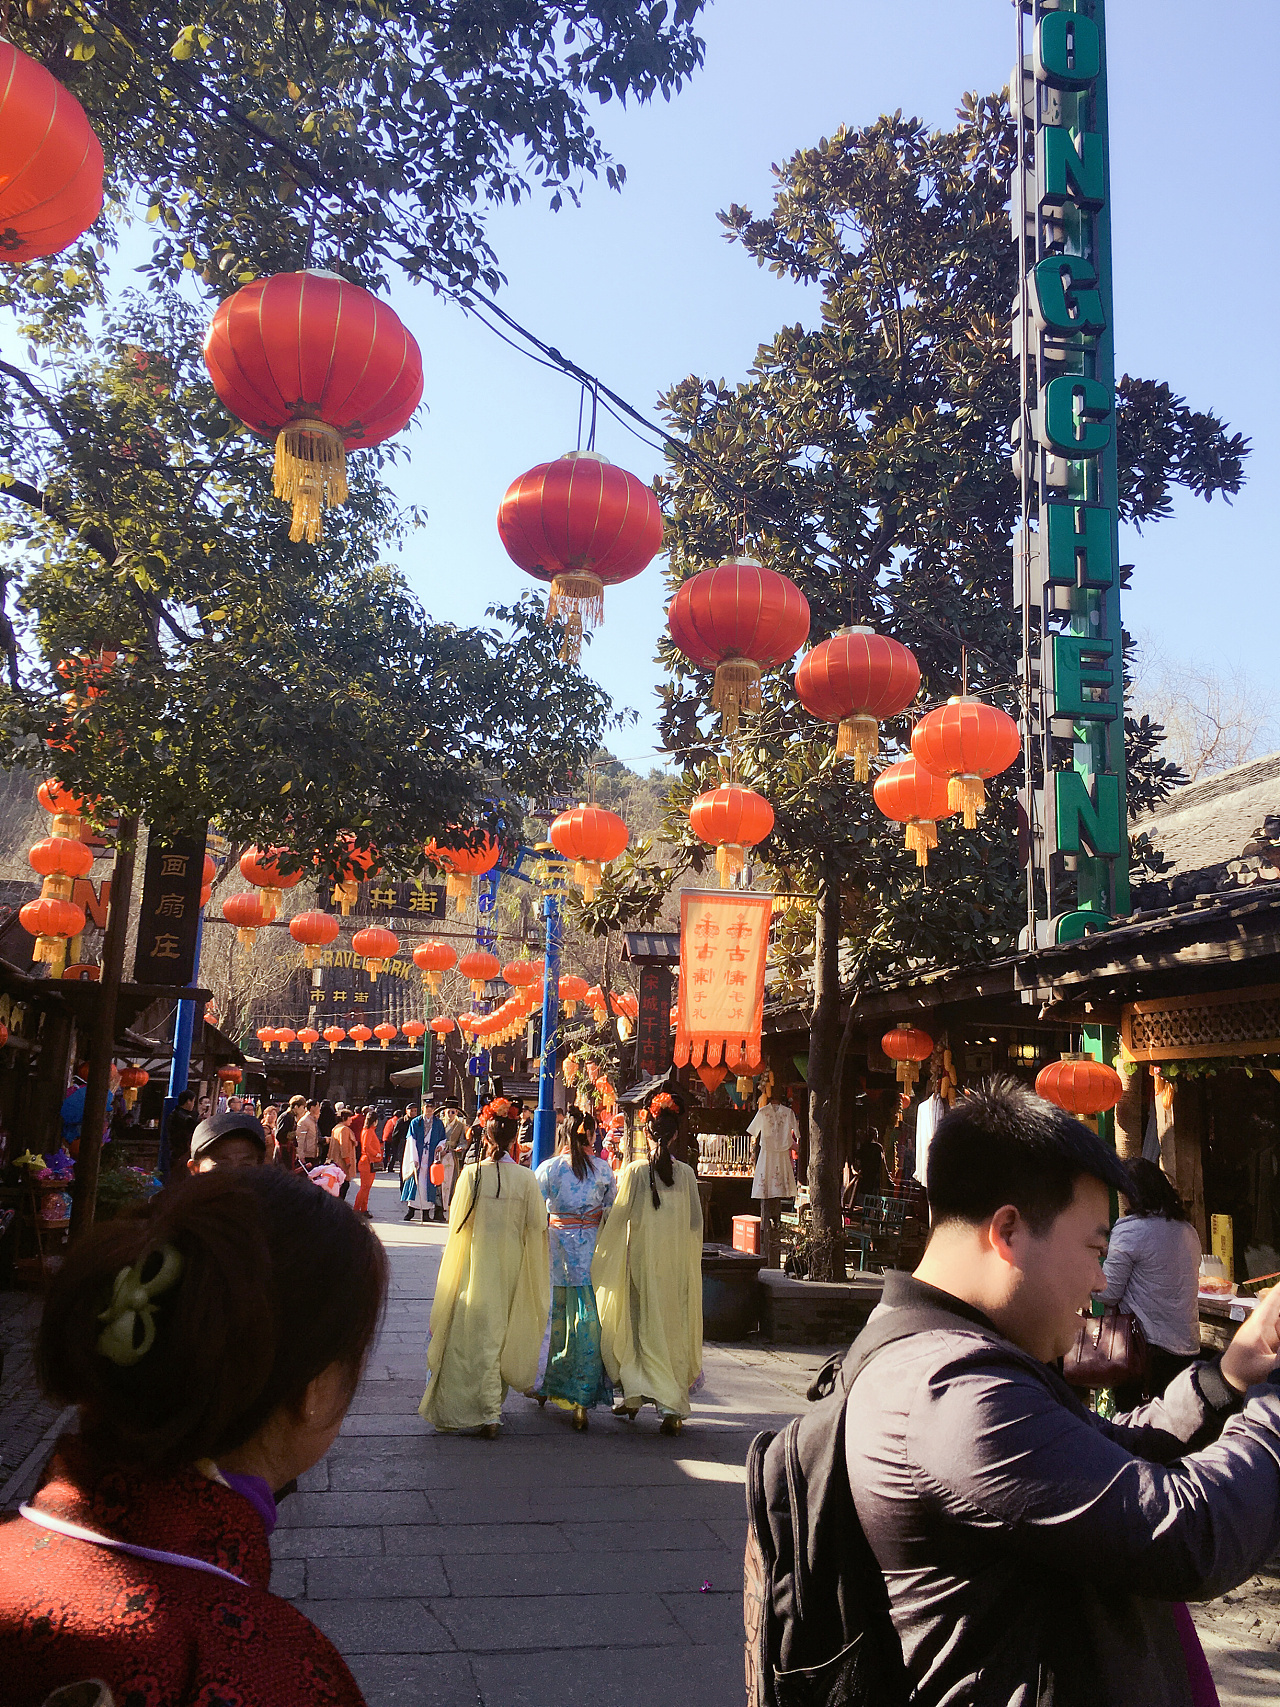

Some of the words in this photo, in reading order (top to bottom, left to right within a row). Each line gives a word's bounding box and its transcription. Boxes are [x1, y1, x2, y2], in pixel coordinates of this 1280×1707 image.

[151, 818, 190, 958] 画扇庄
[314, 950, 368, 969] RAVEL
[373, 957, 413, 981] ARK
[310, 988, 369, 1003] 市井街
